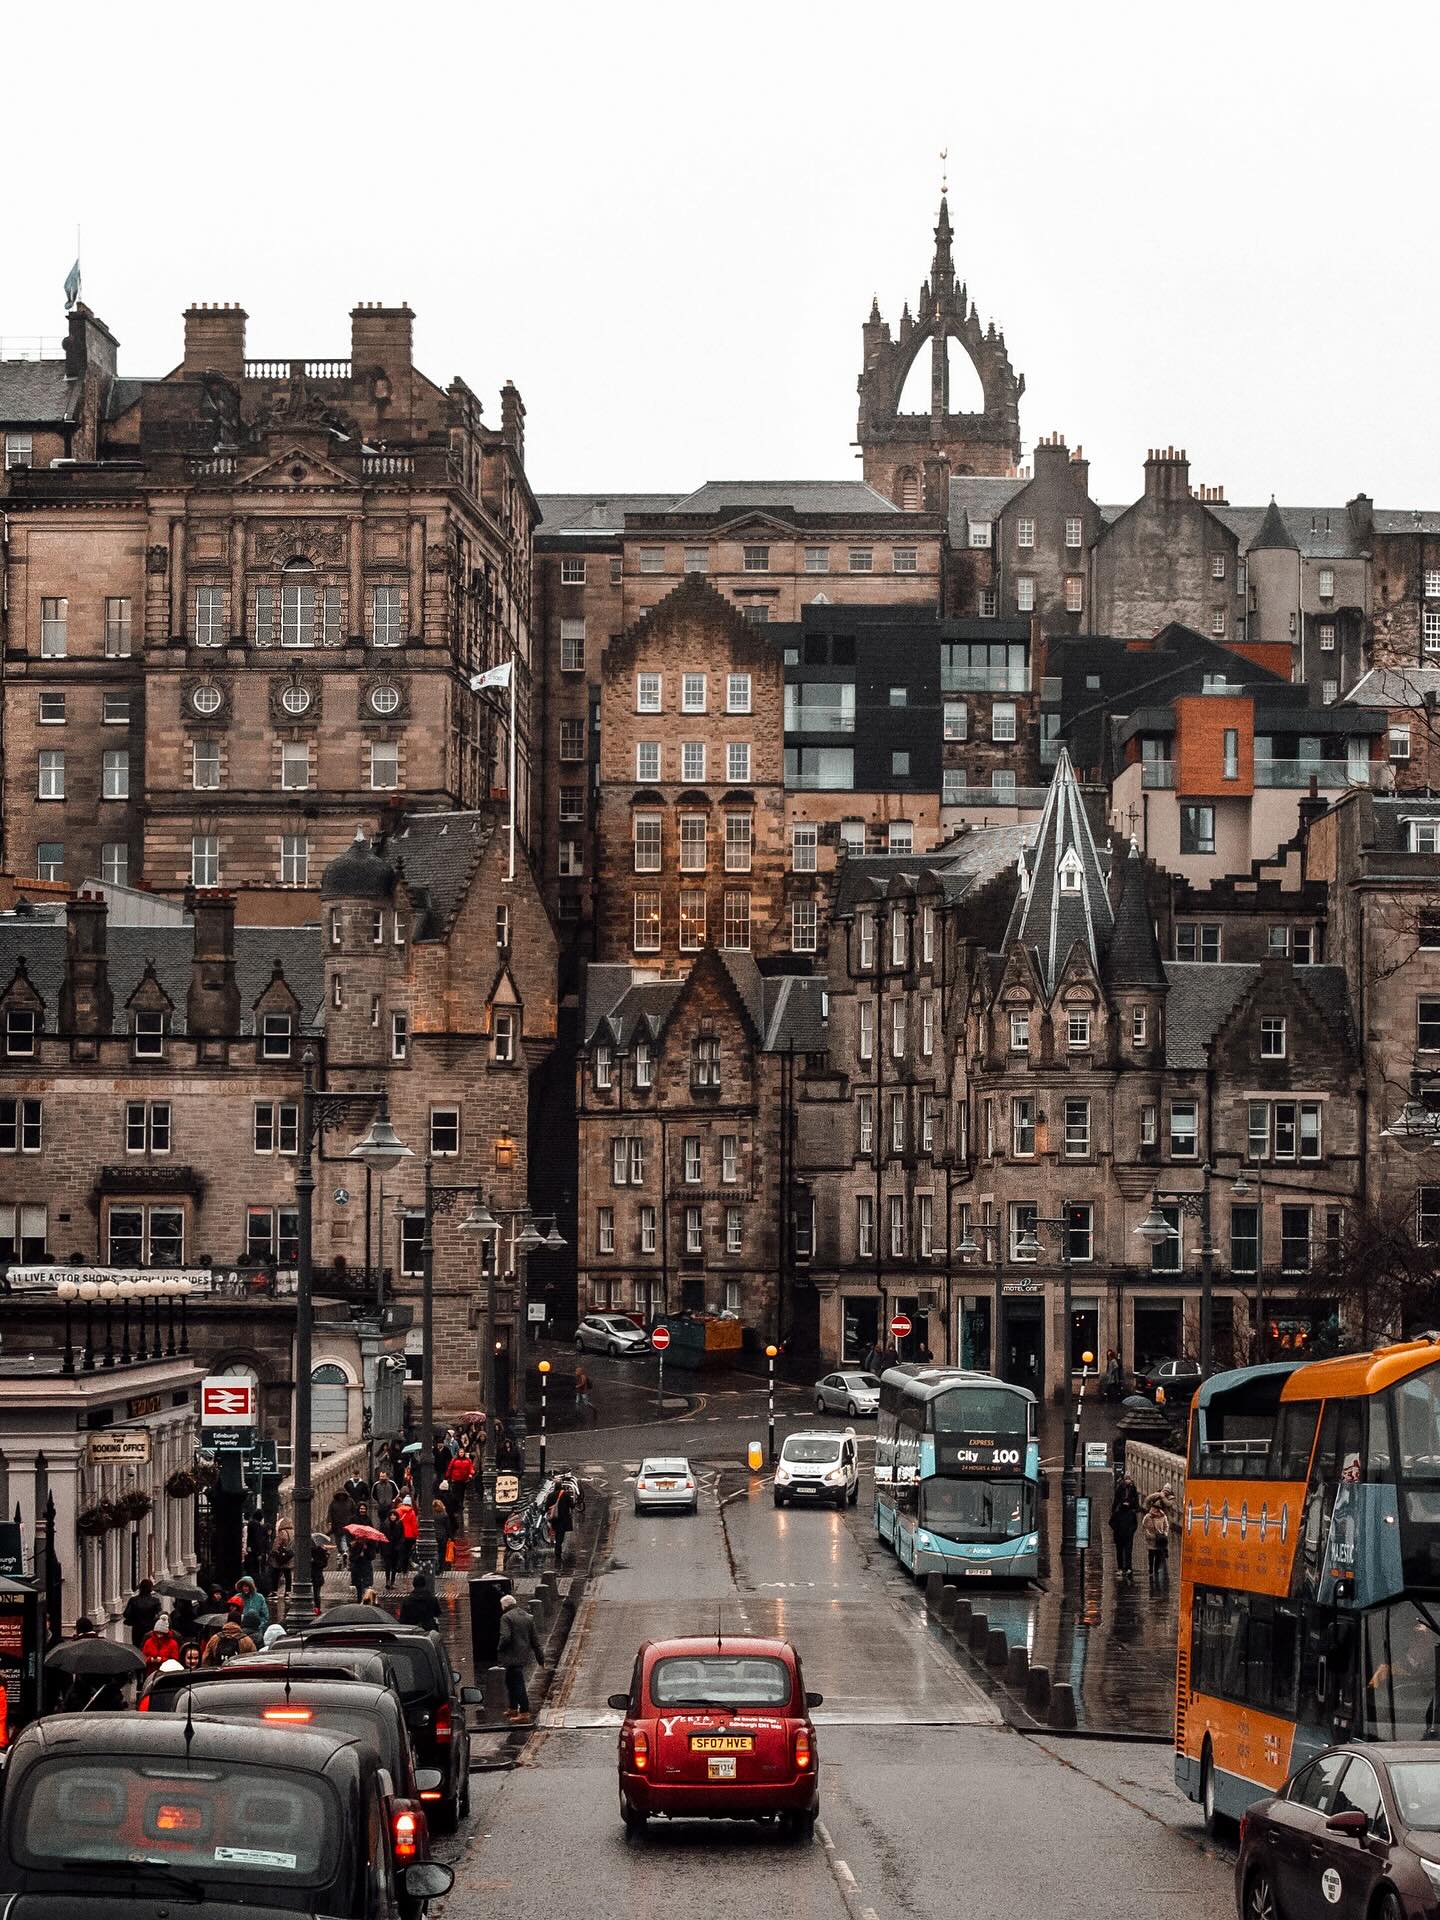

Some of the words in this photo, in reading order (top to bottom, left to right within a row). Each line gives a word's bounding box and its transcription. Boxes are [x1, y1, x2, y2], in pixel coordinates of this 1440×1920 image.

[24, 1273, 46, 1282] LIVE
[48, 1273, 80, 1283] ACTOR
[212, 1432, 240, 1440] Edinburgh
[214, 1439, 239, 1447] Waverley
[92, 1444, 121, 1453] BOOKING
[122, 1443, 146, 1452] OFFICE
[957, 1450, 978, 1462] City
[992, 1449, 1019, 1463] 100
[696, 1739, 723, 1748] SF07
[727, 1739, 747, 1748] HVE
